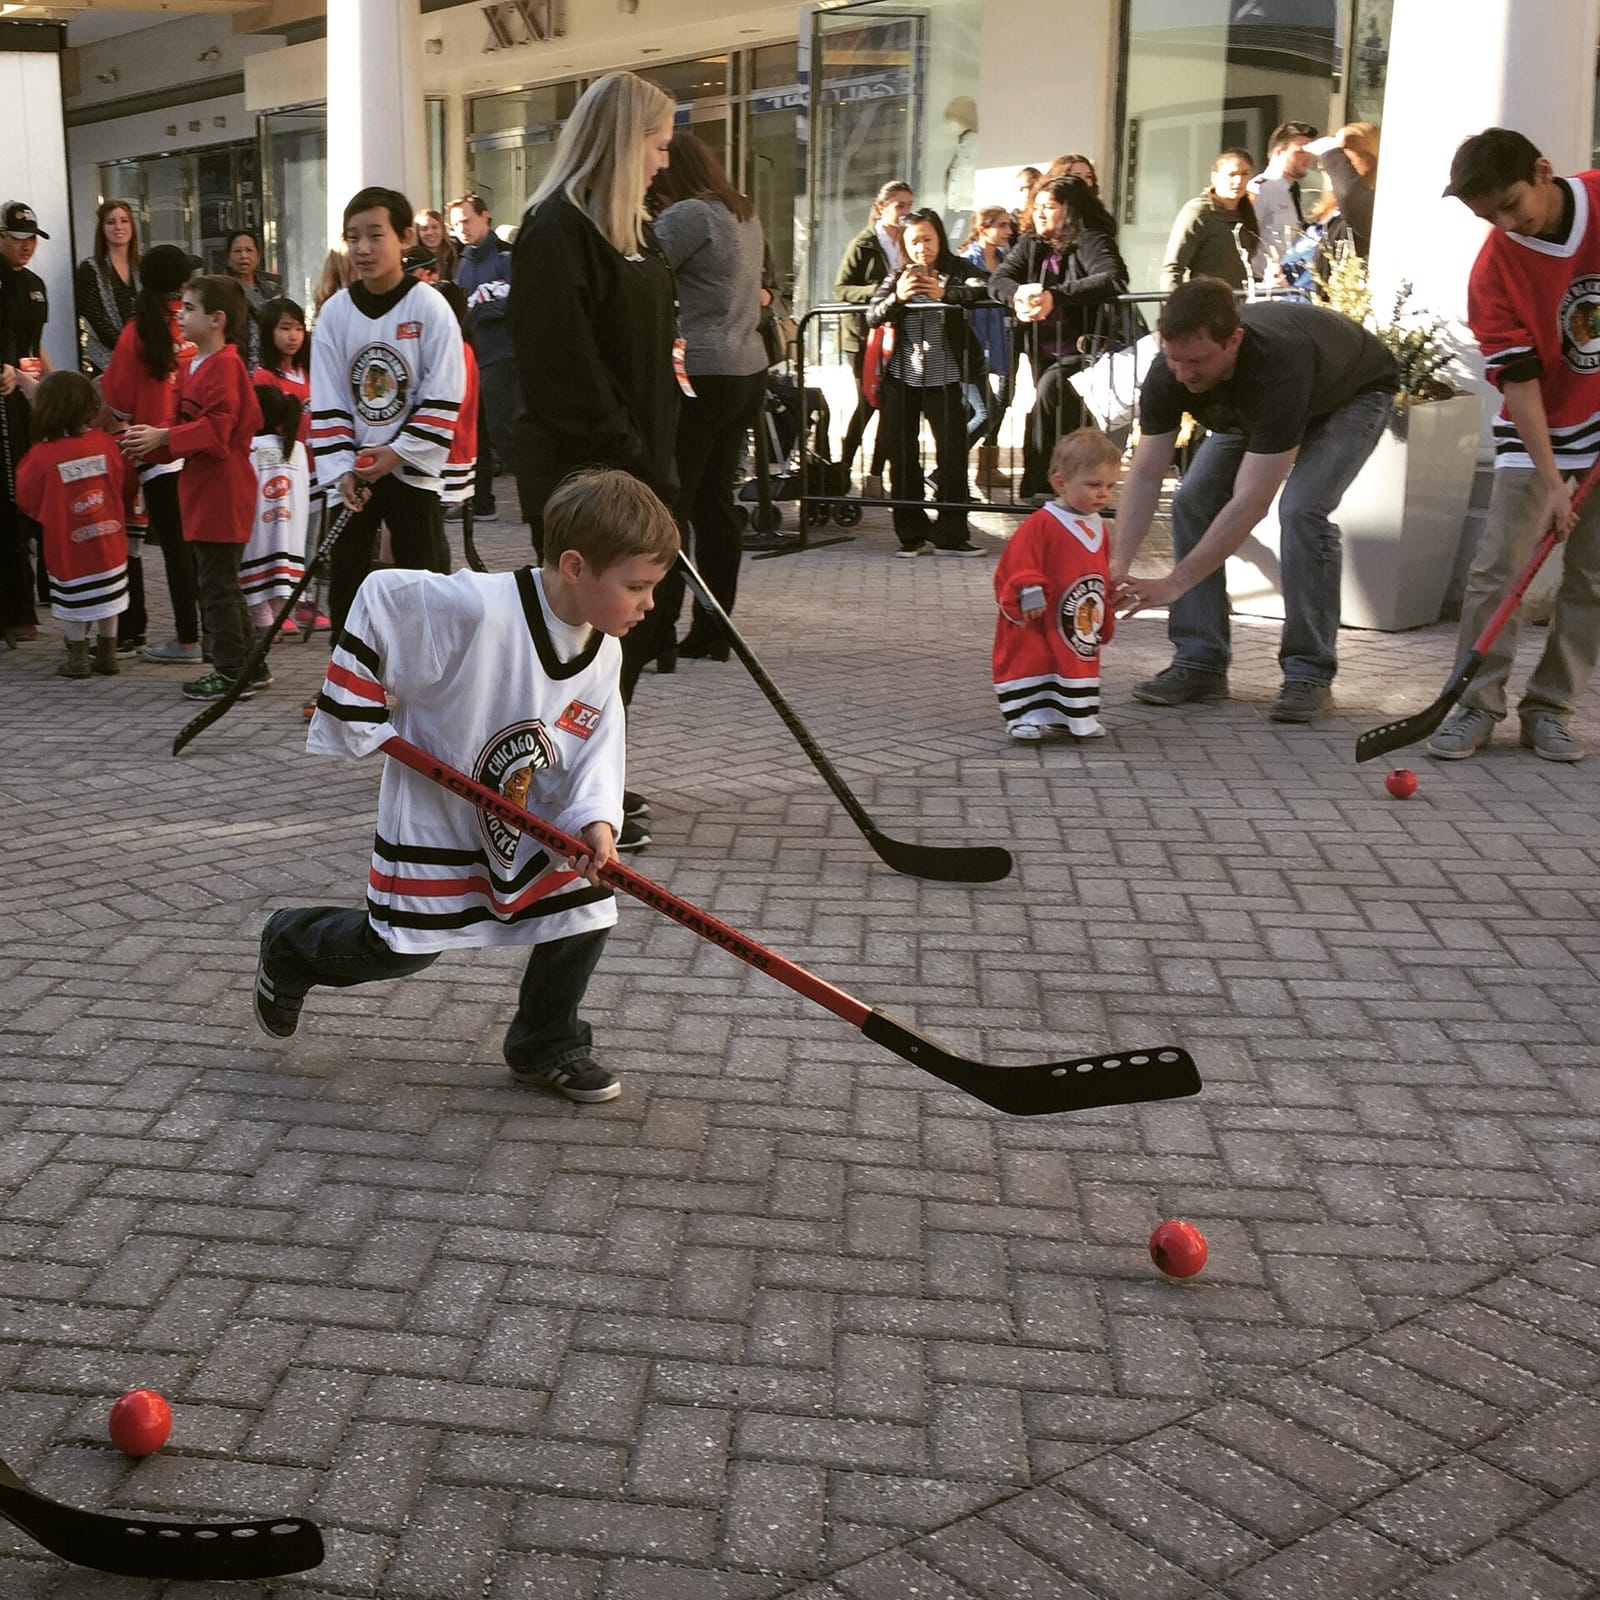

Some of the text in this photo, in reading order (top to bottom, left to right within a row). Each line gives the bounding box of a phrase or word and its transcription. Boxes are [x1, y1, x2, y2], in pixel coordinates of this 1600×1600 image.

[488, 733, 535, 777] CHICAGO
[487, 811, 518, 857] OCKE
[447, 777, 770, 969] CHICAGO ACKHAWKS
